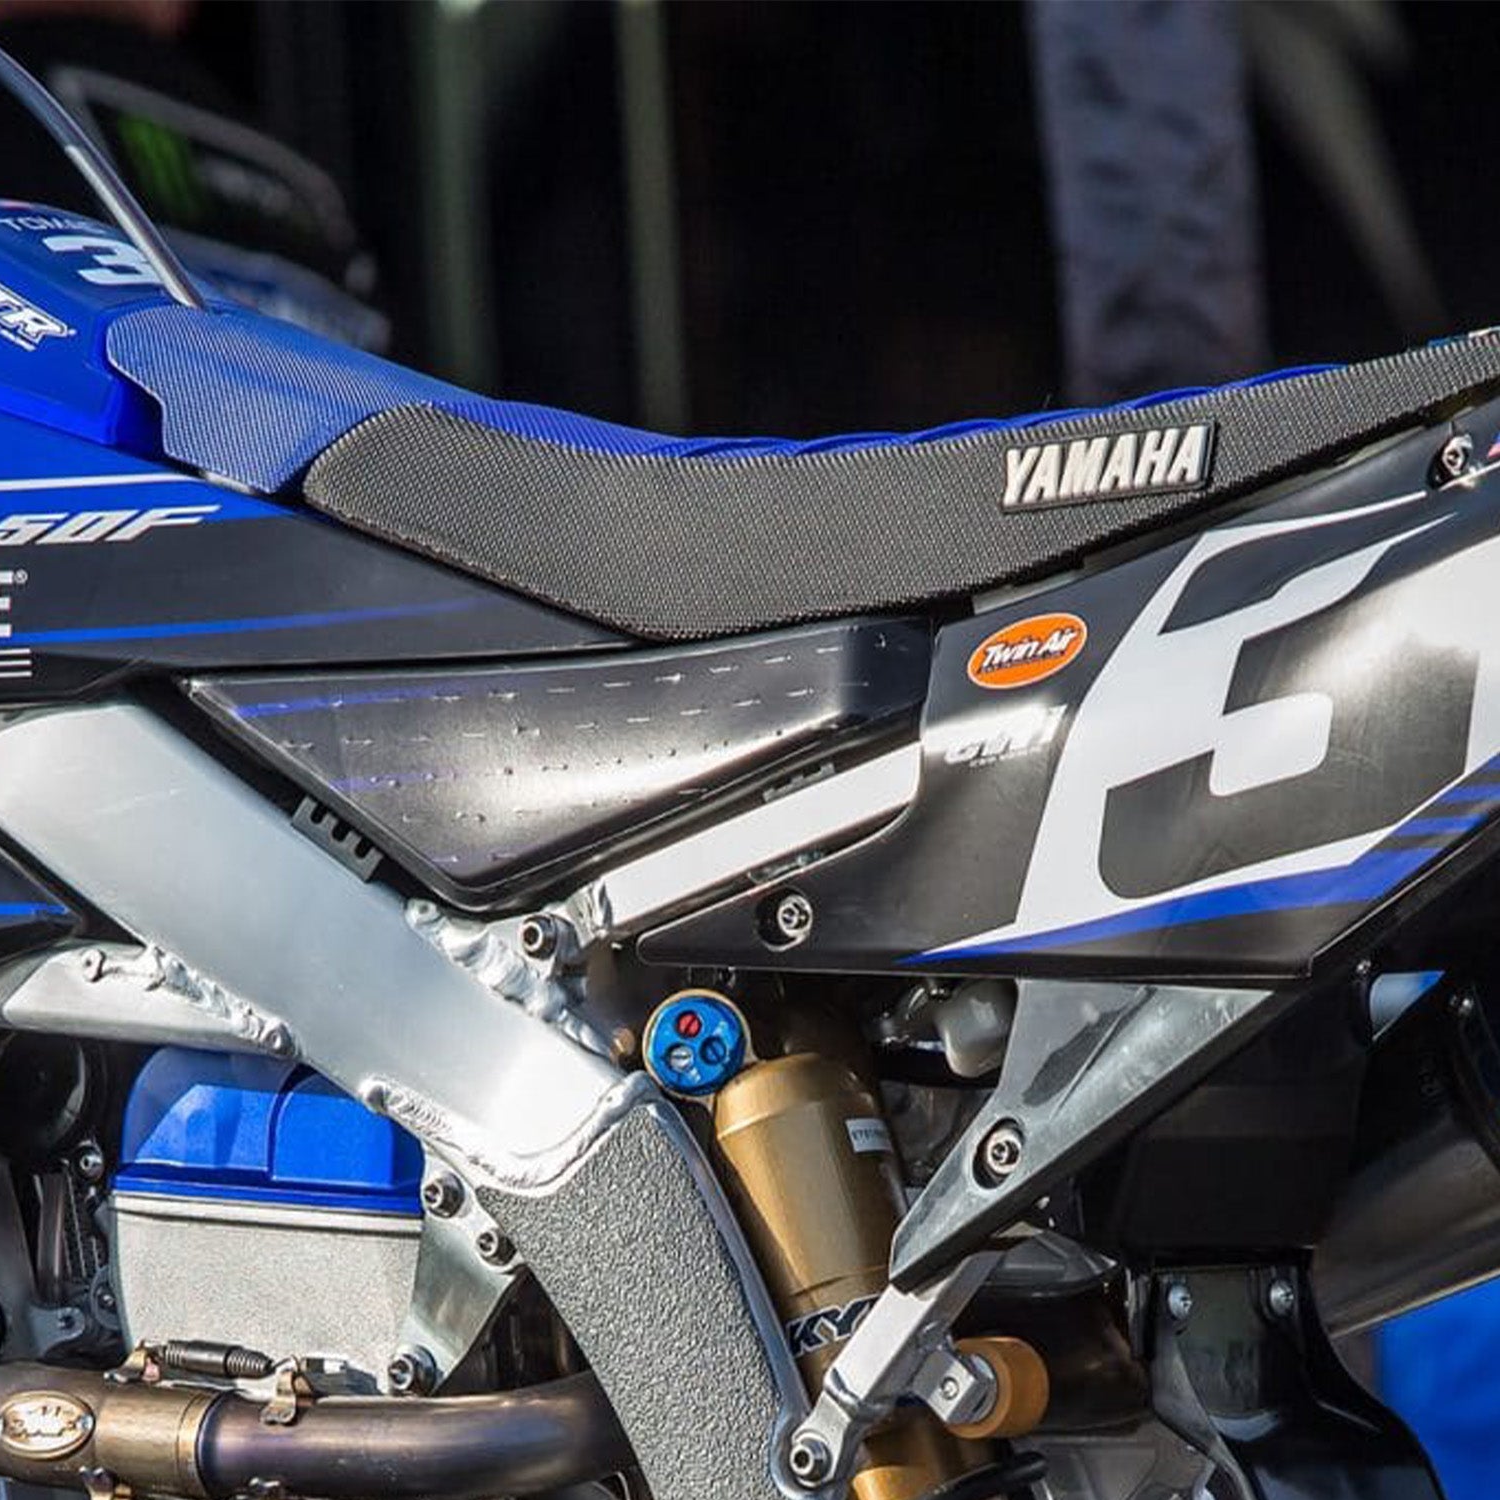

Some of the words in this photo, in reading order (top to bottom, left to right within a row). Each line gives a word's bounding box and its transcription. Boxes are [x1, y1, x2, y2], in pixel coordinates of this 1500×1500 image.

[43, 235, 166, 285] 3
[1003, 425, 1208, 505] YAMAHA
[981, 635, 1039, 669] Twin
[1039, 627, 1078, 655] Air
